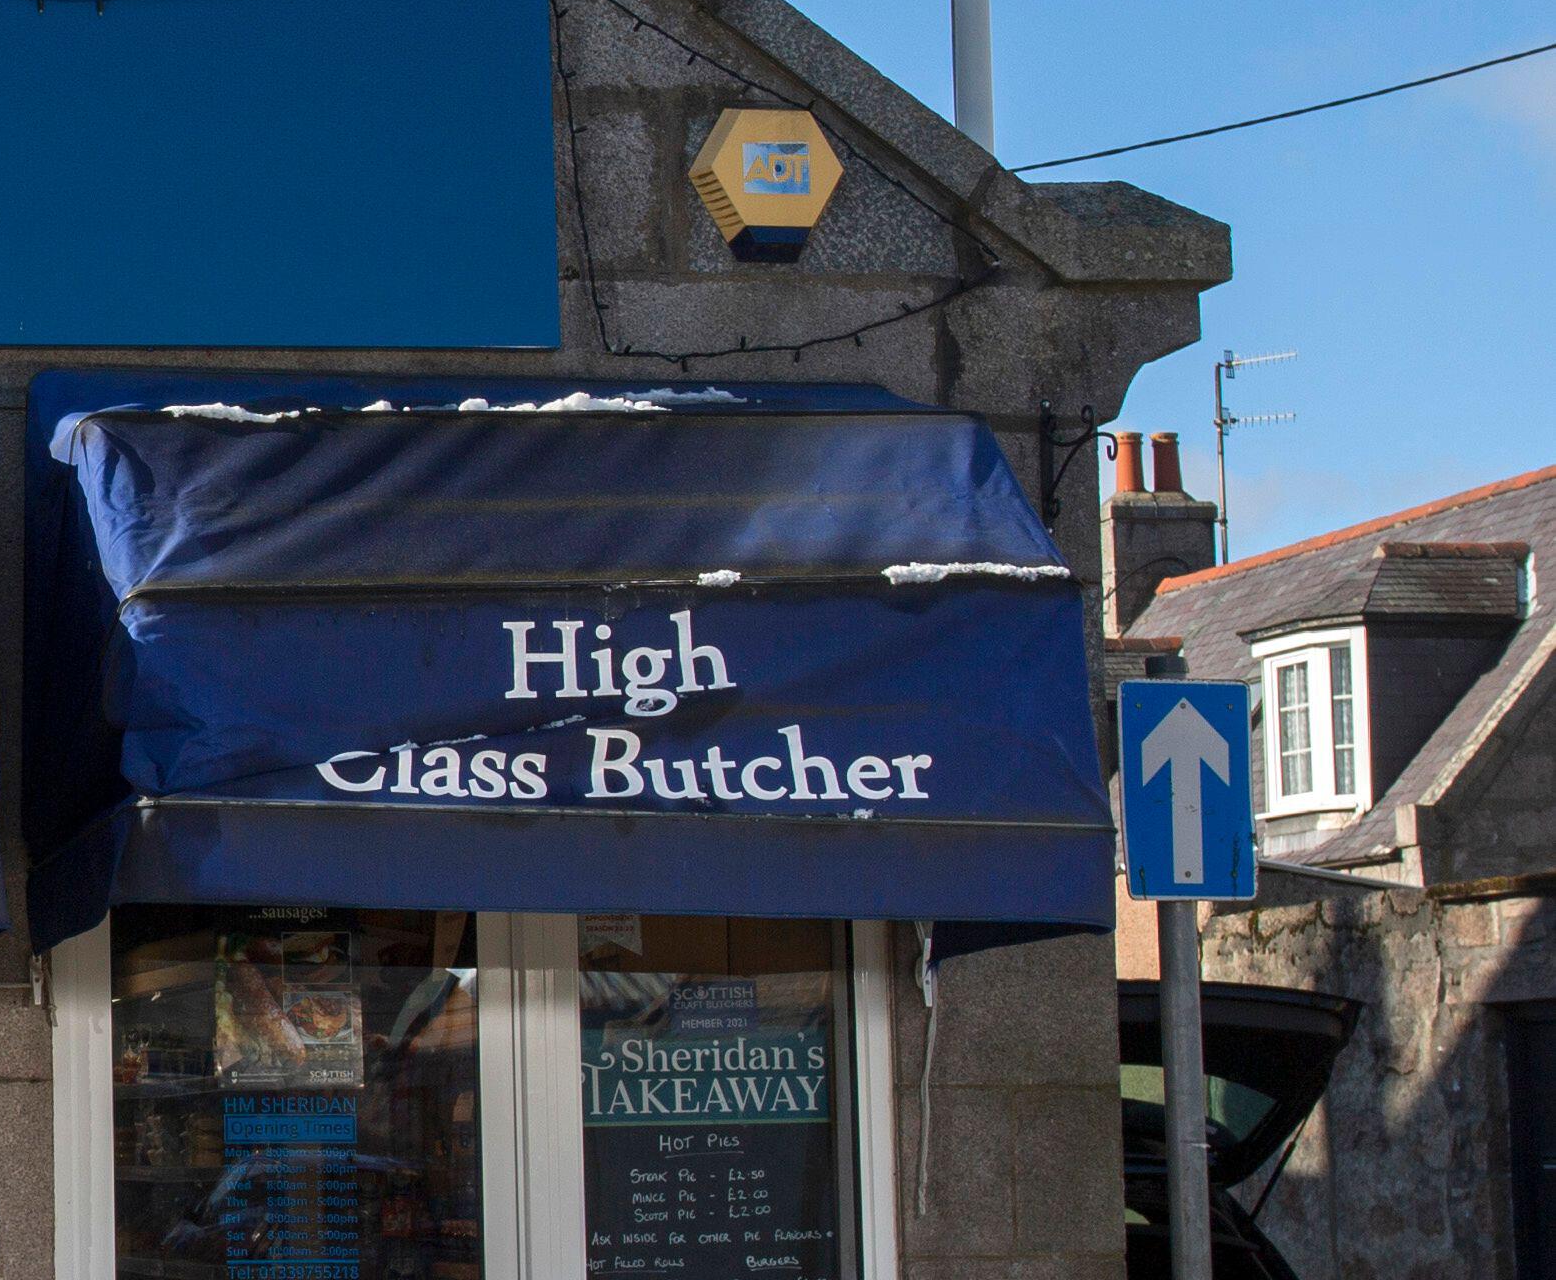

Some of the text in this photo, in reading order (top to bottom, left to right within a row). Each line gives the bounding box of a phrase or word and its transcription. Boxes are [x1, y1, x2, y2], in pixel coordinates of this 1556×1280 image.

[744, 153, 810, 184] ADT
[502, 609, 737, 717] High
[316, 724, 933, 800] Class Butcher
[674, 984, 754, 1000] SCOTTISH
[681, 1019, 722, 1029] MEMBER
[622, 1032, 825, 1073] Sheridan's
[581, 1053, 826, 1115] TAKEAWAY
[224, 1096, 358, 1114] HM SHERIDAN
[231, 1121, 351, 1139] Opening Times
[660, 1133, 740, 1151] HOT PIES
[630, 1168, 668, 1183] STEAK
[678, 1168, 697, 1182] PIE
[632, 1192, 666, 1204] MINCE
[679, 1189, 697, 1202] PIE
[677, 1210, 696, 1221] PIE
[591, 1232, 612, 1245] ASK
[623, 1233, 658, 1243] INSIDE
[698, 1233, 732, 1243] OTHER
[744, 1232, 761, 1242] PIE
[655, 1257, 684, 1267] ROLLS
[746, 1255, 799, 1268] BURGERS
